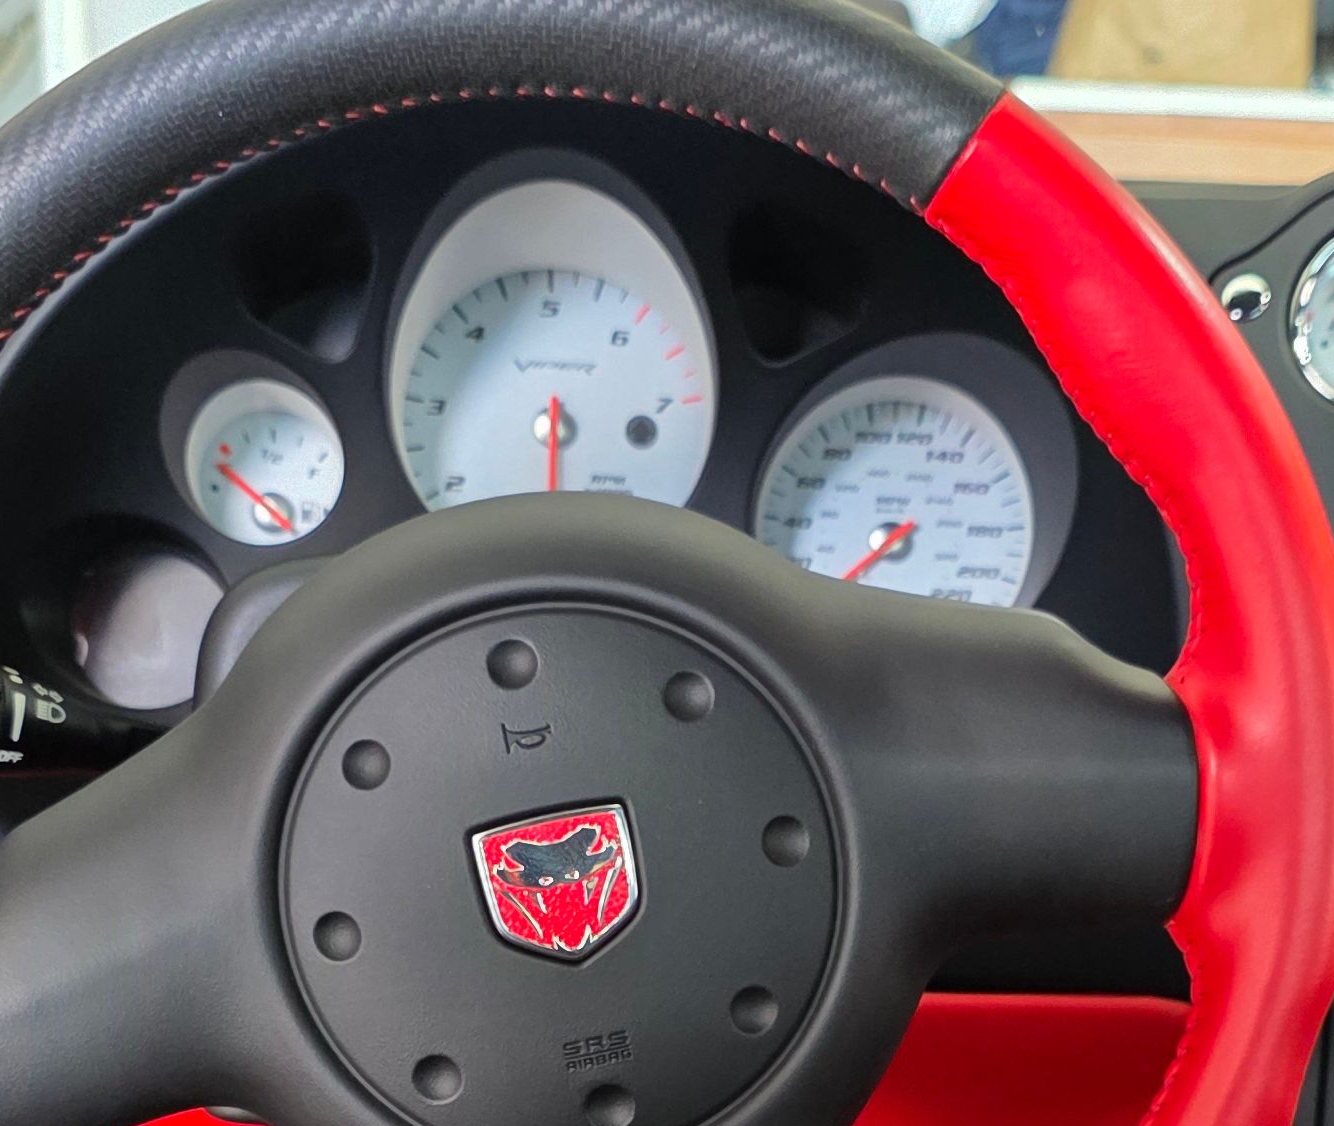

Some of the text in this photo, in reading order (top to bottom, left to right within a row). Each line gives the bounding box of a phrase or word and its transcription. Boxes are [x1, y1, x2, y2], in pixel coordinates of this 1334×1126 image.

[539, 301, 560, 318] 5
[465, 326, 485, 341] 4
[611, 330, 629, 347] 6
[427, 401, 445, 415] 3
[656, 399, 673, 413] 7
[897, 433, 933, 445] 120
[925, 452, 964, 463] 140
[445, 477, 465, 491] 2
[783, 518, 811, 529] 40
[967, 526, 1003, 538] 180
[957, 568, 1000, 579] 200
[563, 1030, 629, 1056] SRS
[566, 1048, 632, 1072] AIRBAG
